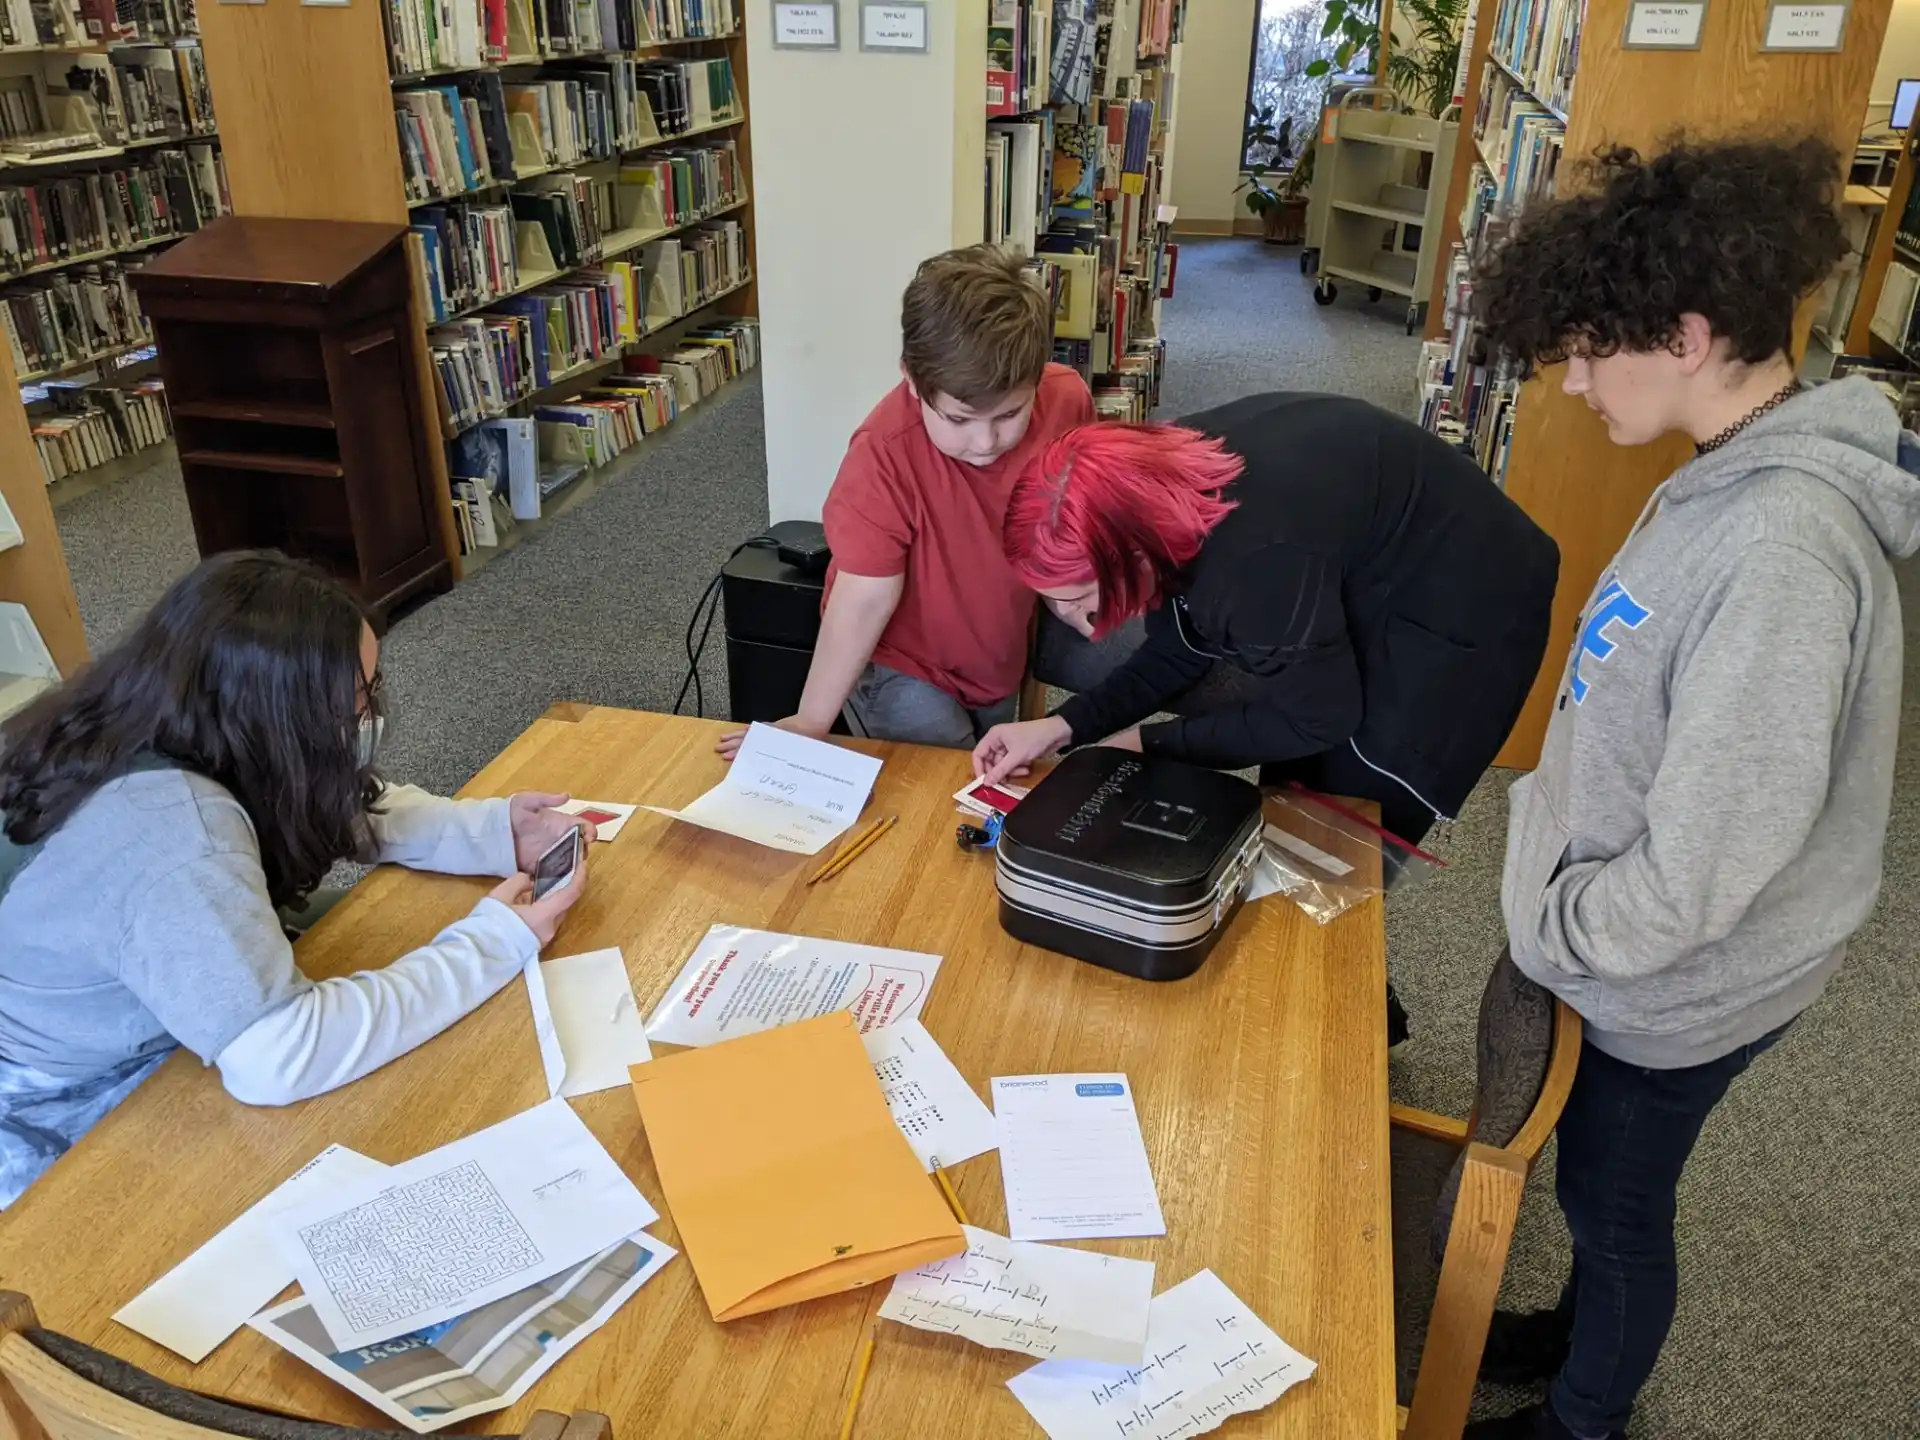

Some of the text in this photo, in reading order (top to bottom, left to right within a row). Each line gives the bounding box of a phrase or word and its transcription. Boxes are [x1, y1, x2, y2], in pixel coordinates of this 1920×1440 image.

[825, 800, 844, 812] BLUE
[688, 950, 738, 1018] Thank you for your
[884, 983, 905, 1015] Welcome
[860, 1014, 876, 1034] Publ
